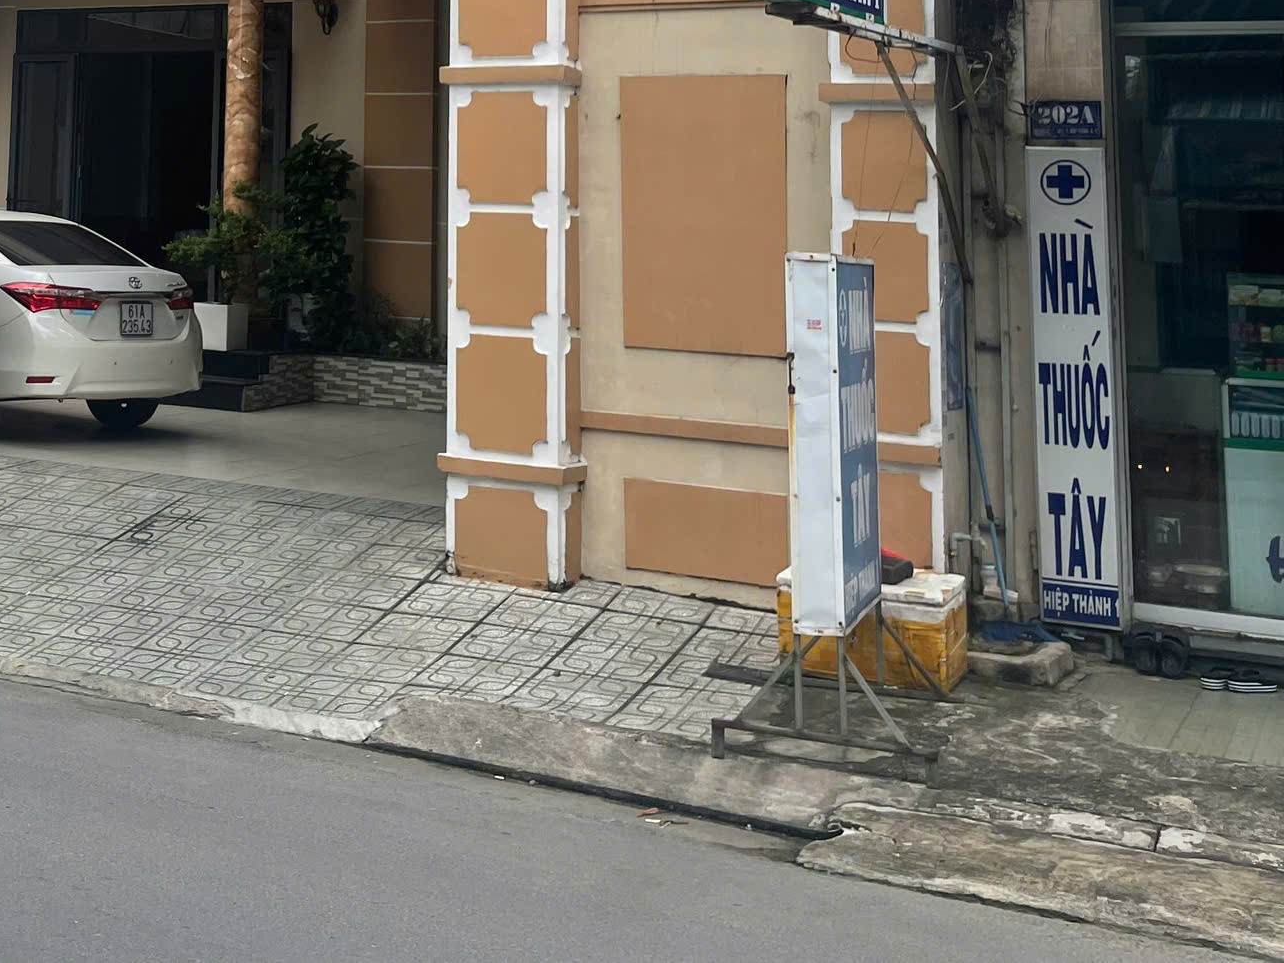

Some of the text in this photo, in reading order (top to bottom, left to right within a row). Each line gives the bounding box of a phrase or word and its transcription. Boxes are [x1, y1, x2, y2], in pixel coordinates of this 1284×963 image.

[1037, 104, 1095, 125] 202A
[1039, 217, 1101, 316] NHÀ
[122, 319, 153, 334] 235.43
[128, 304, 146, 319] 61A
[1038, 329, 1110, 452] THUỐC
[1046, 477, 1107, 581] TÂY
[1043, 586, 1070, 617] HIỆP
[1071, 589, 1112, 617] THÀNH
